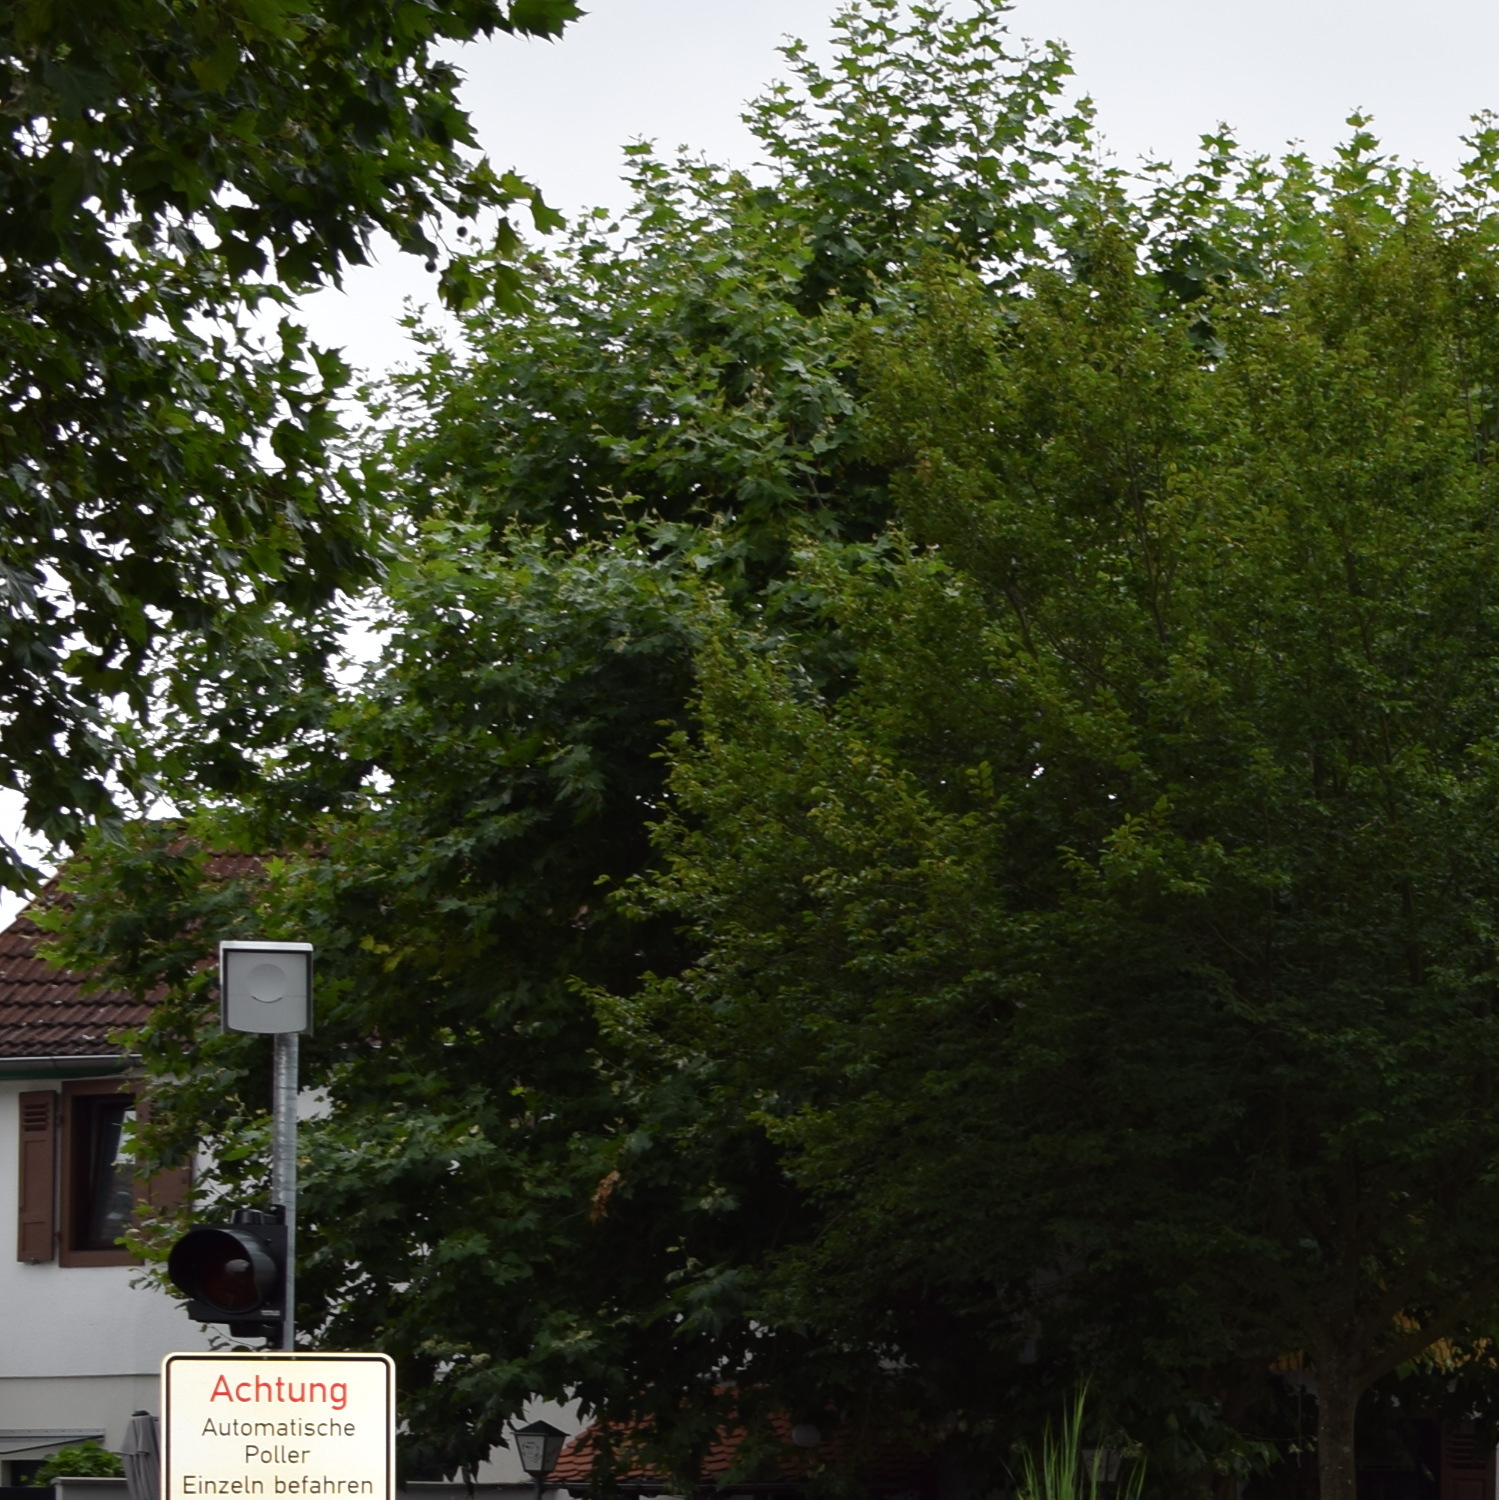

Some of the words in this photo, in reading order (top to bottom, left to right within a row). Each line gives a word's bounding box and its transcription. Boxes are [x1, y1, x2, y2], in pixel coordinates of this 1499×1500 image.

[209, 1374, 347, 1410] Achtung
[201, 1417, 356, 1437] Automatische
[244, 1444, 311, 1464] Poller
[182, 1475, 264, 1494] Einzeln
[274, 1475, 373, 1494] befahren
